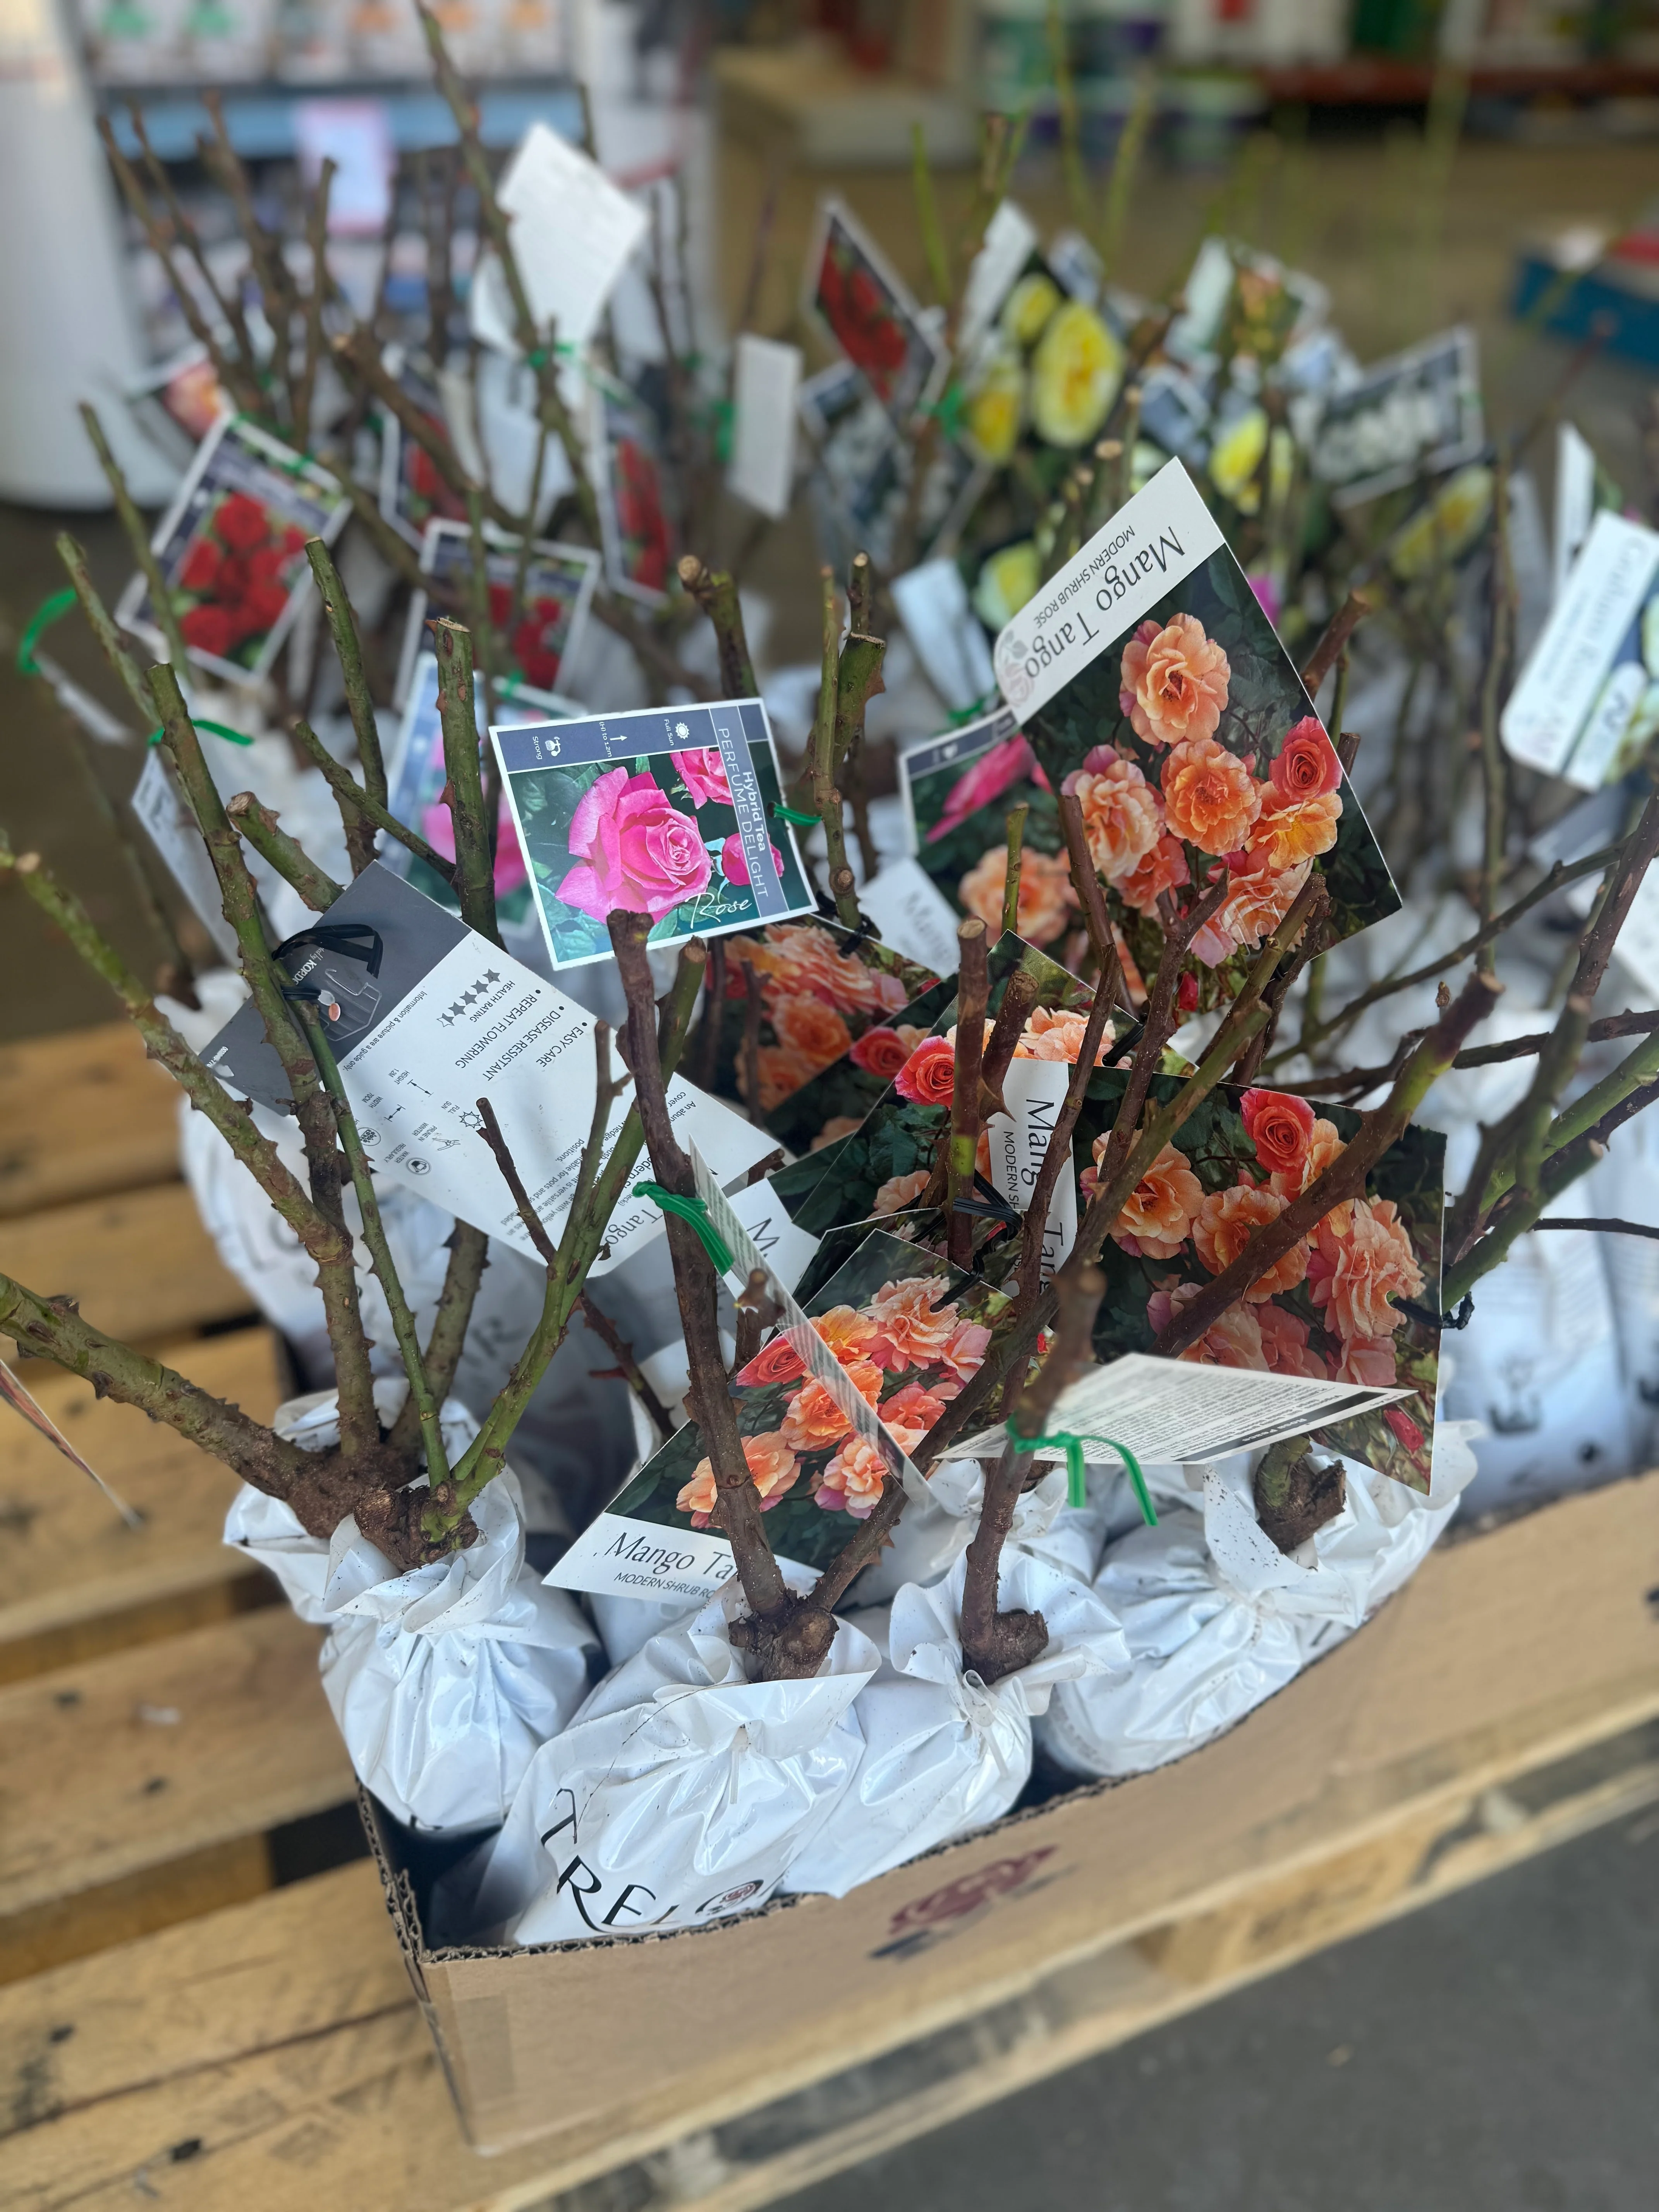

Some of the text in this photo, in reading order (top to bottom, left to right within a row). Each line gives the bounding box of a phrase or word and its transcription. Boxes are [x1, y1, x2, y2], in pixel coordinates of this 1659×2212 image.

[1035, 525, 1135, 628] MODERN SHRUB ROSE
[1025, 526, 1185, 678] Mango Tango
[664, 719, 672, 733] Full
[532, 736, 543, 760] Strong
[719, 728, 768, 898] PERFUME DELIGHT
[742, 771, 766, 852] Hybrid Tea
[684, 892, 752, 930] Rose
[292, 959, 318, 985] KORDE
[397, 991, 428, 1018] Information
[469, 980, 515, 1022] HEALTH RATING
[378, 1021, 396, 1038] picture
[455, 994, 538, 1068] REPEAT FLOWERING
[369, 1037, 380, 1046] are
[483, 1010, 561, 1081] DISEASE RESISTANT
[536, 1026, 584, 1067] EASY CARE
[354, 1048, 368, 1061] guide
[343, 1061, 356, 1071] only.
[394, 1070, 410, 1085] HEIGHT
[361, 1092, 374, 1103] 70CM
[368, 1096, 383, 1109] WIDTH
[441, 1101, 452, 1109] SUN
[668, 1092, 686, 1107] cover
[684, 1101, 696, 1109] An
[448, 1105, 460, 1114] FULL
[412, 1122, 429, 1136] WINTER
[422, 1125, 437, 1138] PRUNE
[555, 1138, 585, 1162] positions.
[1020, 1099, 1054, 1186] Mang
[384, 1143, 406, 1163] REGULARLY
[394, 1151, 410, 1164] WATER
[1003, 1131, 1019, 1191] MODERN
[544, 1176, 559, 1189] pots
[557, 1170, 569, 1179] for
[533, 1188, 546, 1199] and
[542, 1187, 568, 1206] versatile
[555, 1200, 571, 1212] with
[605, 1209, 663, 1245] Tango
[604, 1532, 695, 1575] Mango
[614, 1572, 716, 1599] MODERN SHRUB RO
